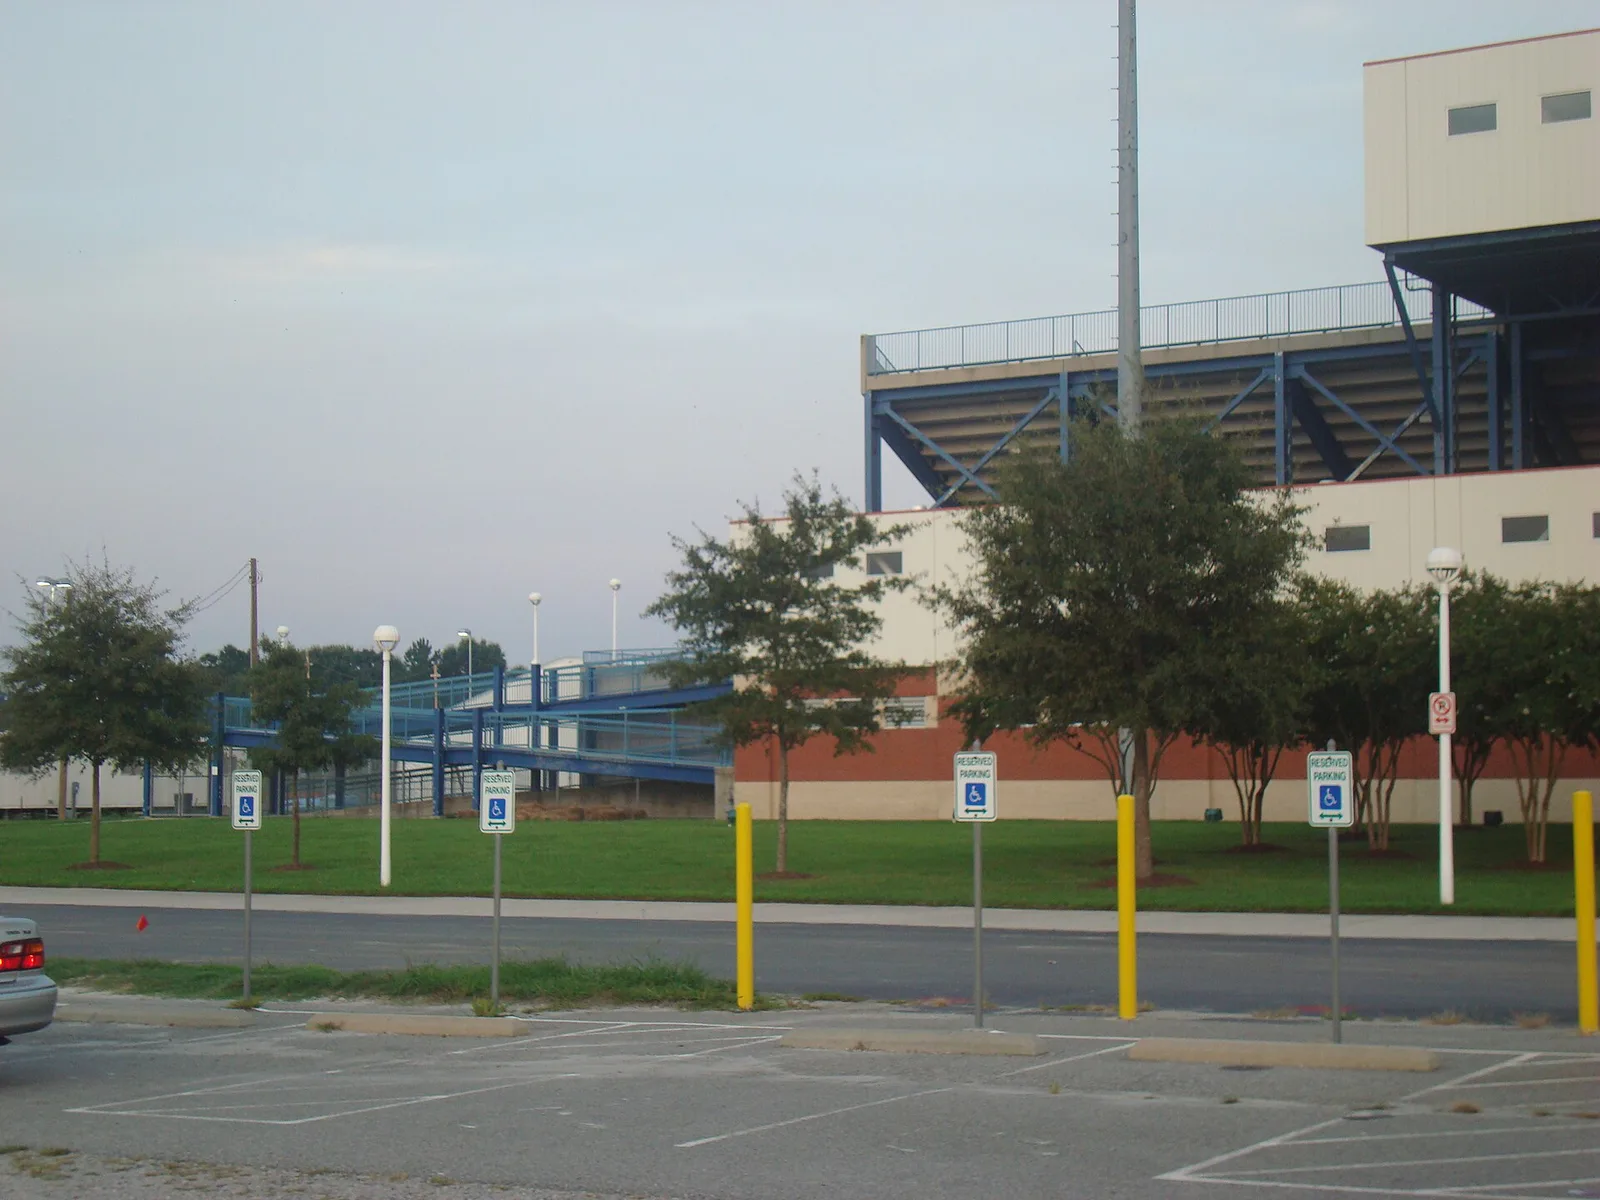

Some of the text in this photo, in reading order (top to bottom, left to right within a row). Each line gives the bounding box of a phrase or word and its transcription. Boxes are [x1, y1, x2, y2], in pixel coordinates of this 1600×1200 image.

[957, 757, 992, 766] RESERVED
[1311, 757, 1348, 767] RESERVED
[960, 769, 991, 778] PARKING
[1314, 771, 1346, 781] PARKING
[234, 774, 259, 783] RESERVED
[484, 775, 512, 783] RESERVED
[236, 785, 257, 793] PARKING
[485, 786, 510, 794] PARKING
